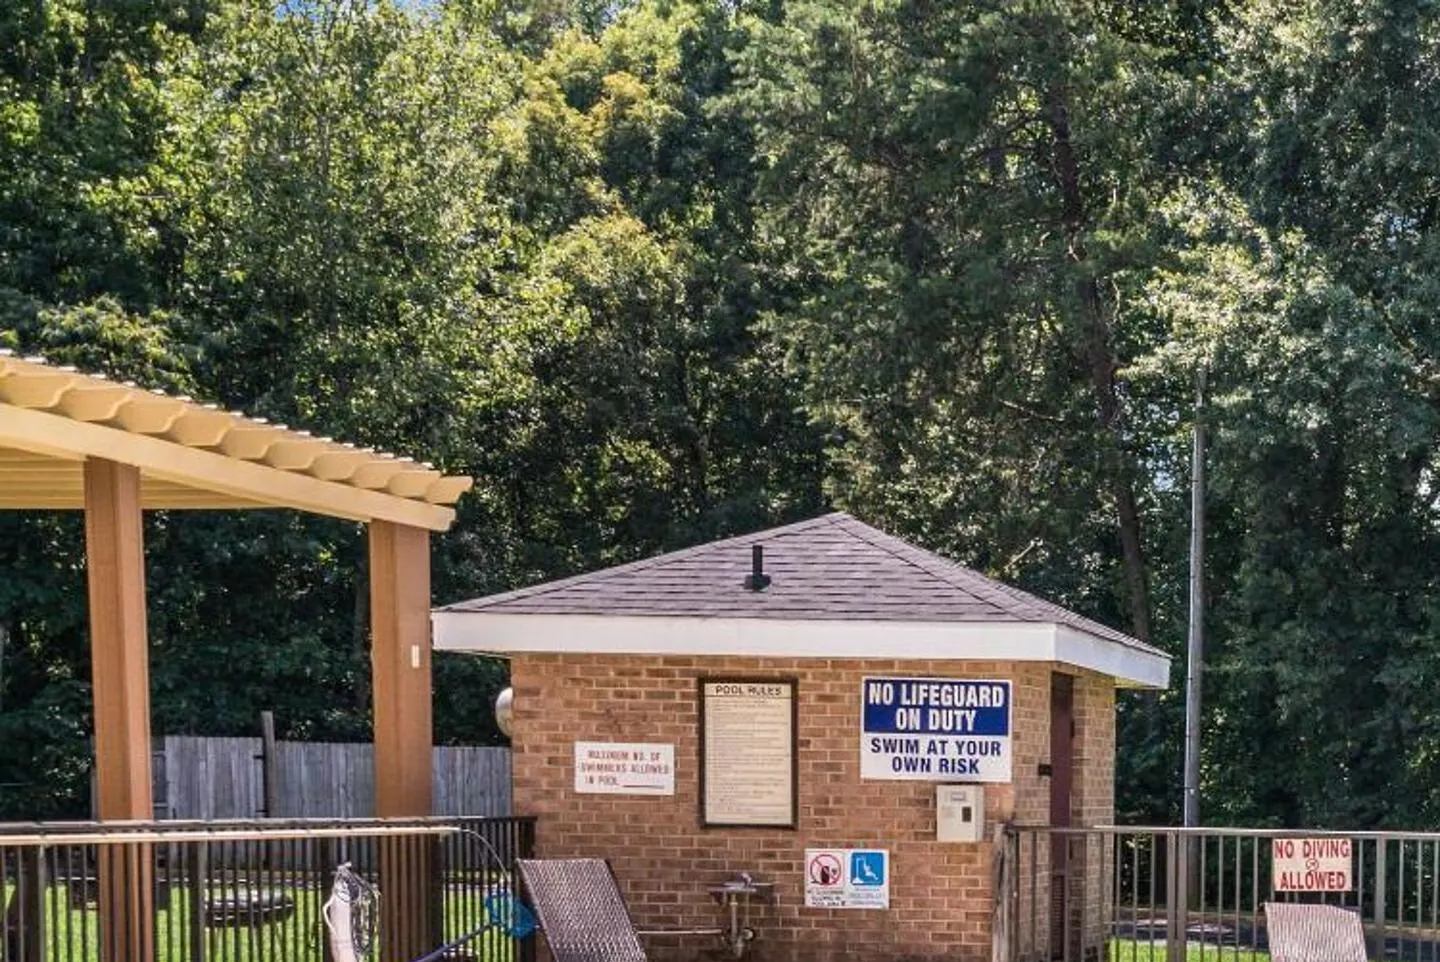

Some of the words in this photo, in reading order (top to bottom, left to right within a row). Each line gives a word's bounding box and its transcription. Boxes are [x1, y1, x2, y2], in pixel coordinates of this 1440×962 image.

[715, 685, 743, 694] POOL
[748, 686, 782, 695] RULES
[869, 683, 894, 706] NO
[901, 684, 1004, 708] LIFEGUARD
[895, 708, 920, 730] ON
[928, 709, 977, 732] DUTY
[871, 738, 919, 754] SWIM
[927, 740, 948, 755] AT
[955, 741, 1002, 756] YOUR
[892, 757, 932, 773] OWN
[938, 758, 980, 774] RISK
[1275, 840, 1295, 858] NO
[1303, 840, 1351, 858] DIVING
[1280, 871, 1346, 890] ALLOWED
